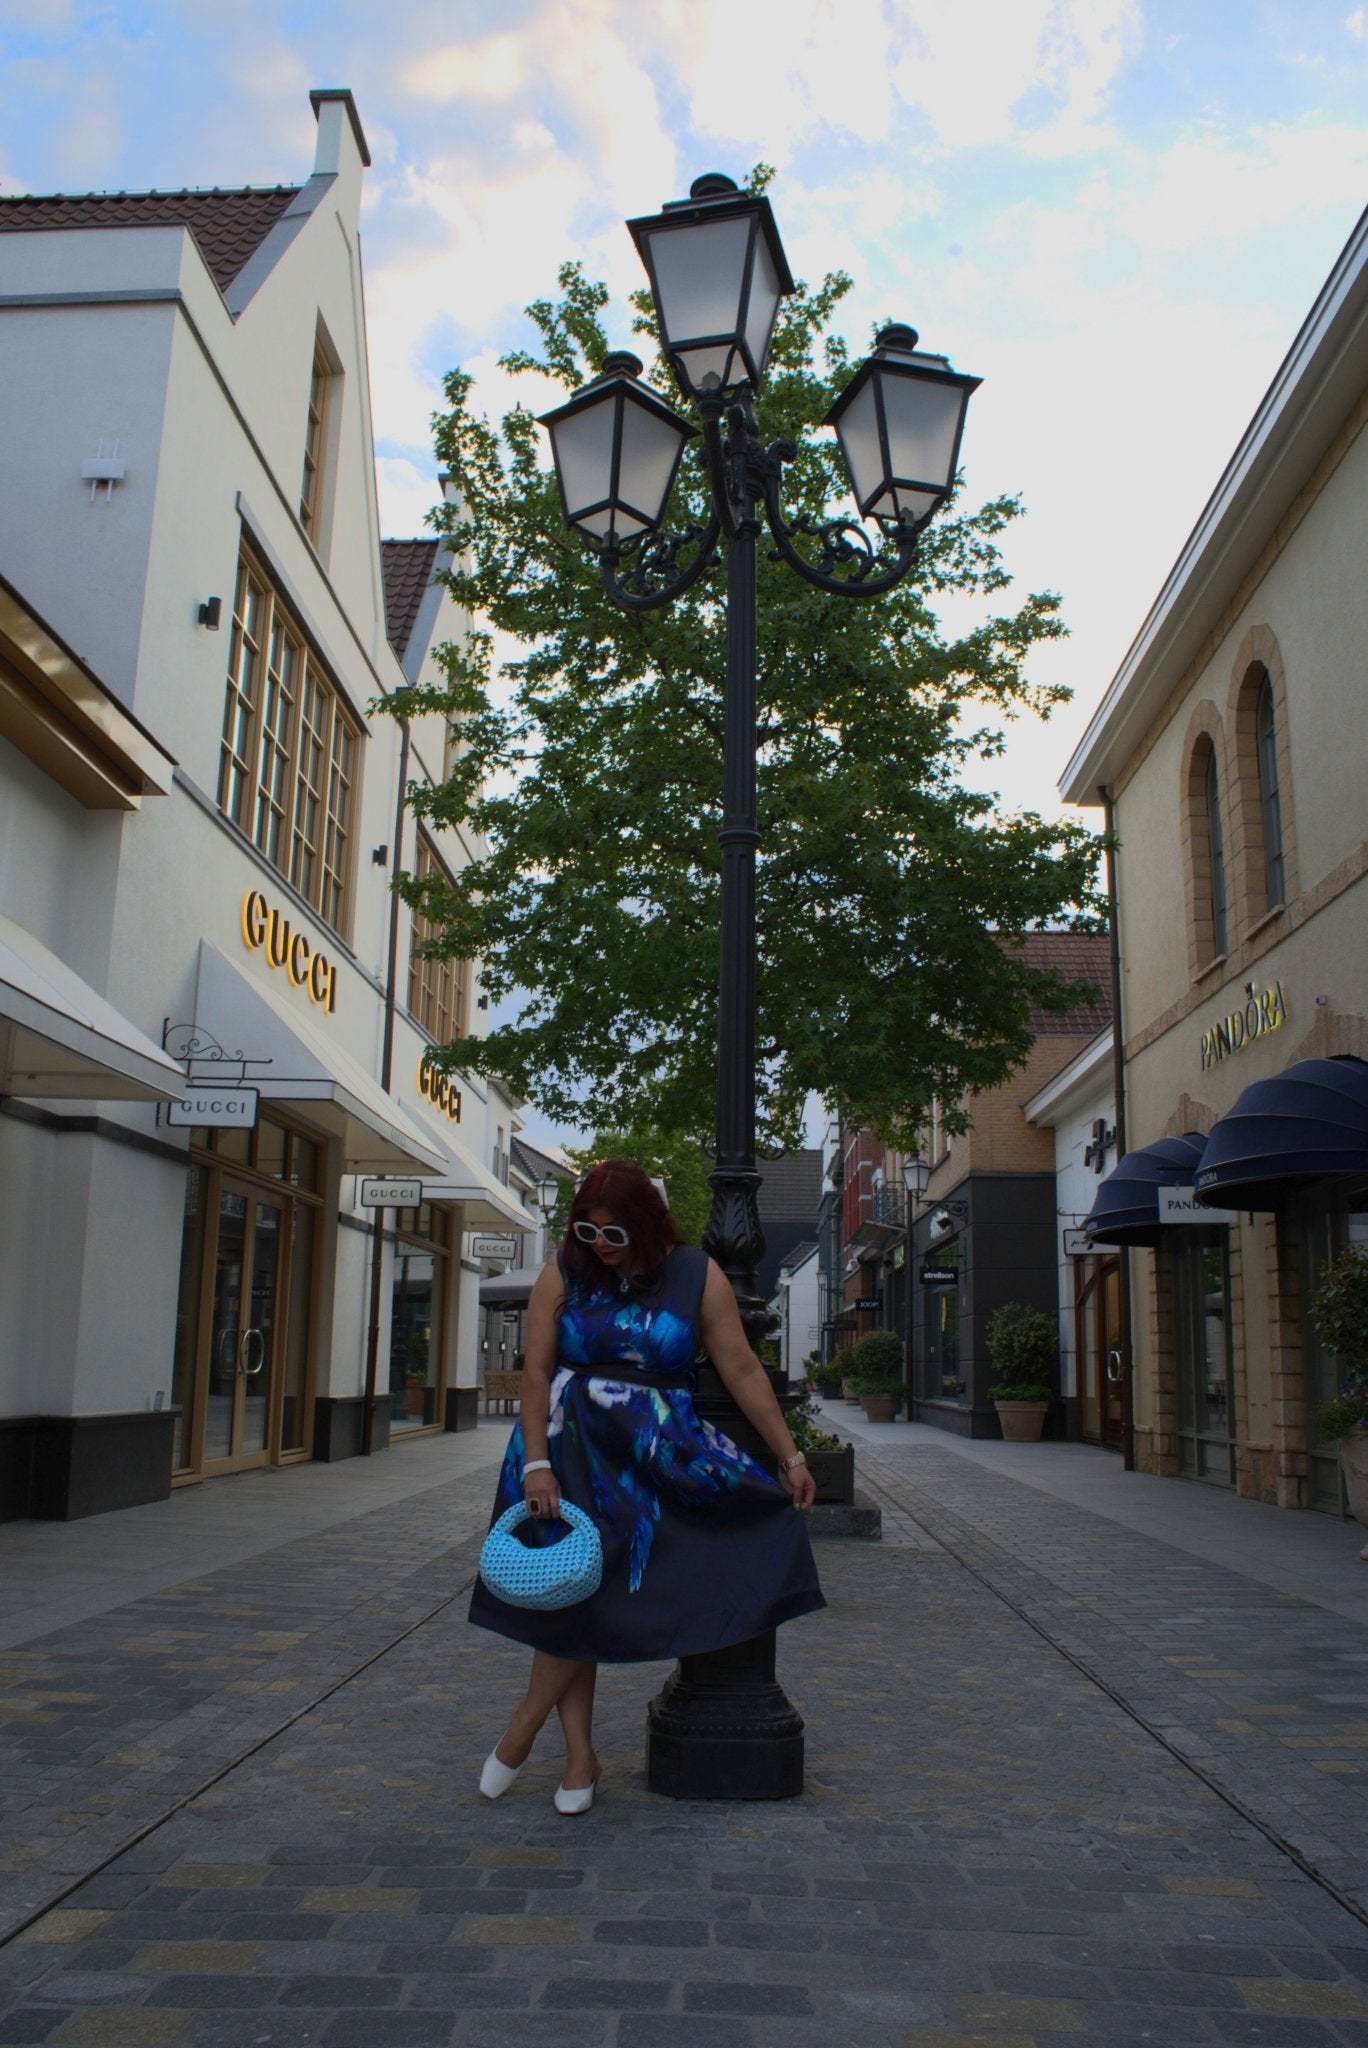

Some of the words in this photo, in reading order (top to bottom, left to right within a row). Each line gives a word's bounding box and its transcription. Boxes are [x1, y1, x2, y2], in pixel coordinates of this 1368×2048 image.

[244, 890, 337, 1013] GUCCI
[1201, 981, 1286, 1071] PANDORA
[181, 1100, 246, 1114] GUCCI
[418, 1058, 462, 1123] GUCCI
[370, 1188, 414, 1198] GUCCI
[479, 1244, 510, 1253] GUCCI
